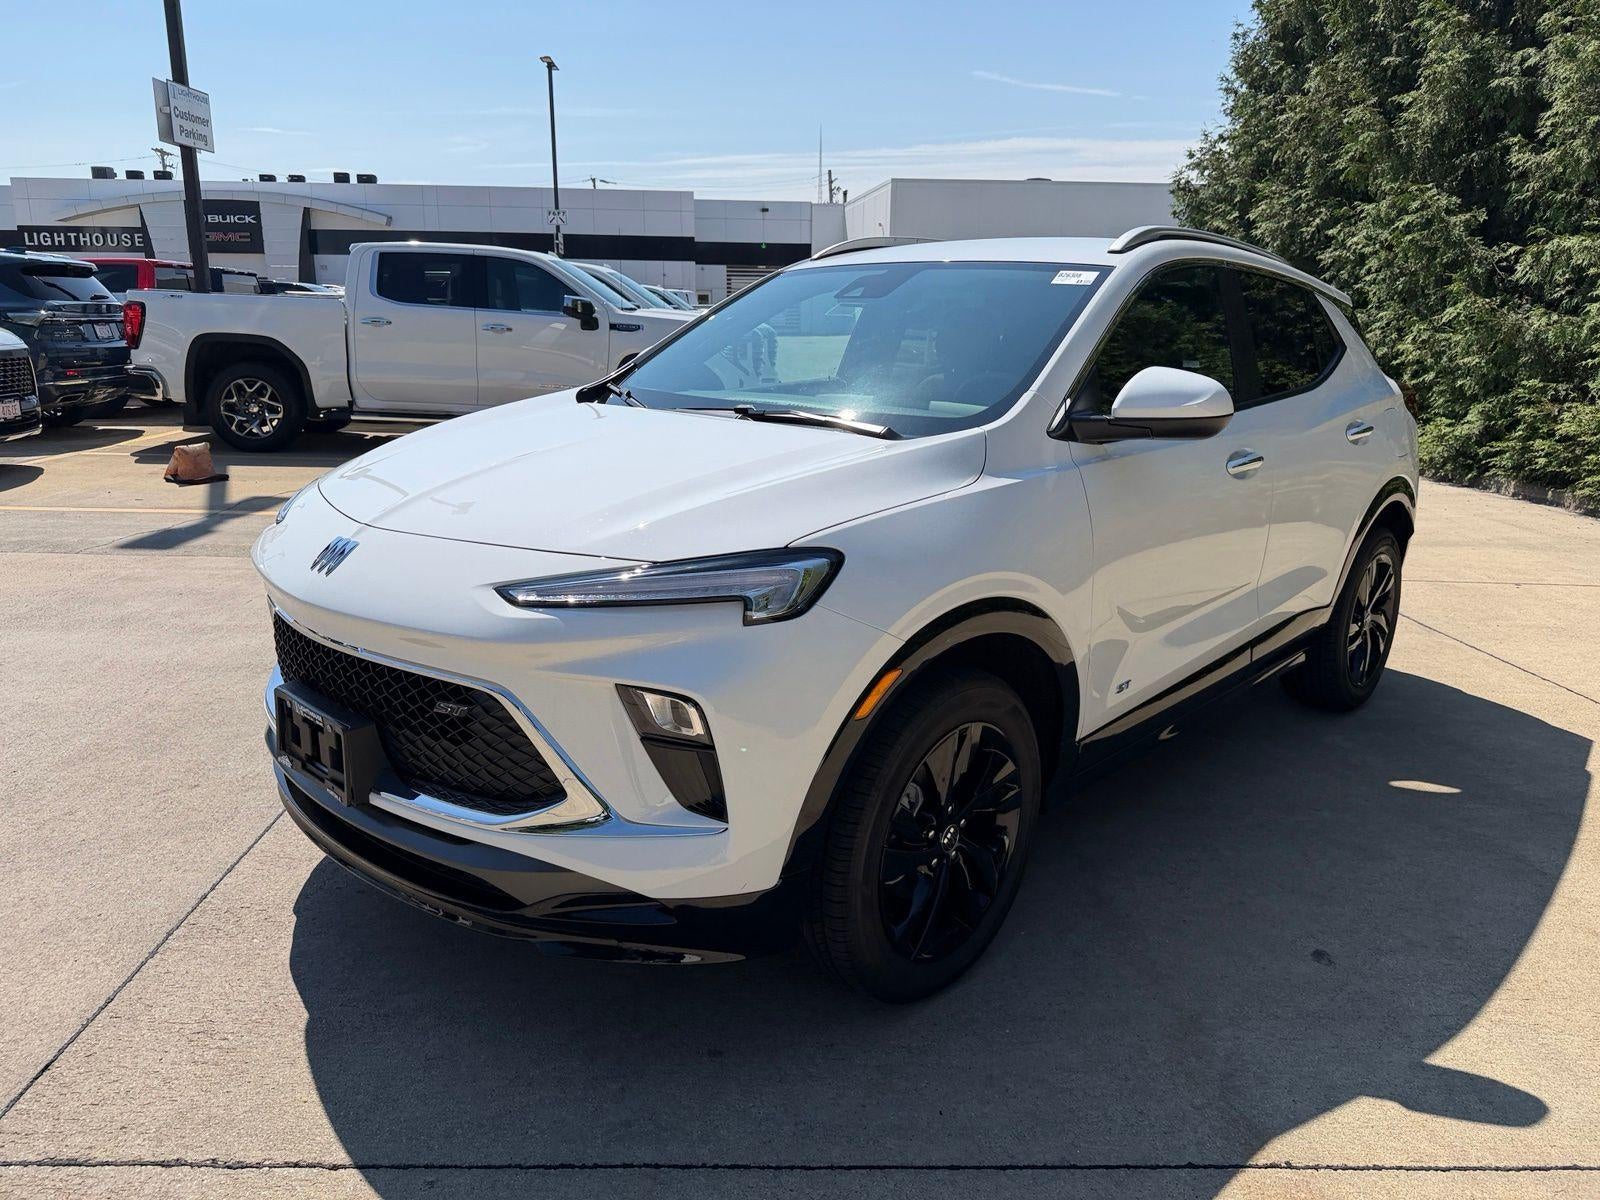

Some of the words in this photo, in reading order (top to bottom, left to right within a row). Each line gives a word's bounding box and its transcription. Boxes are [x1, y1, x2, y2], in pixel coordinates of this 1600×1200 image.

[173, 106, 210, 128] Customer
[179, 124, 208, 146] Parking
[207, 214, 257, 224] BUICK
[24, 231, 144, 248] LIGHTHOUSE
[1115, 679, 1132, 695] ST
[433, 701, 468, 717] ST
